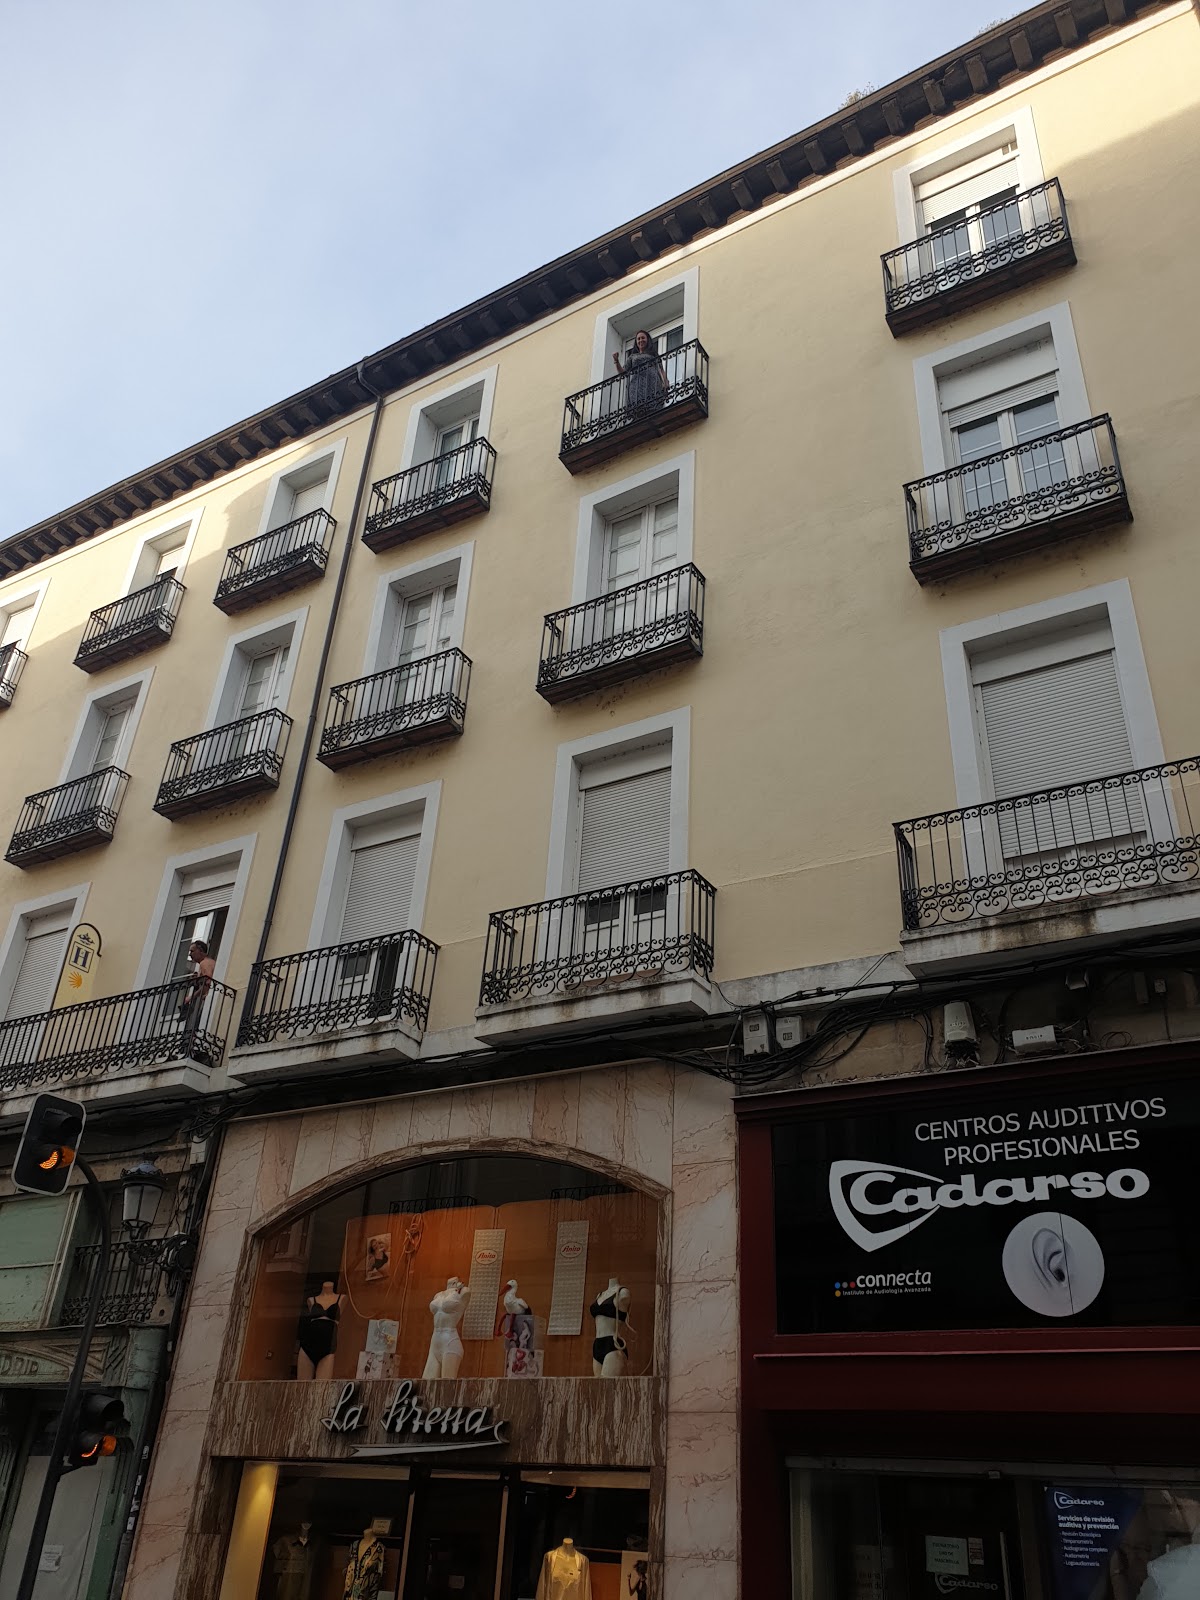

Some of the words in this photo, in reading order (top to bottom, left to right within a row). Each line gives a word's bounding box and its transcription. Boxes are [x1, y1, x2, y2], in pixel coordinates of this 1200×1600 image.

[71, 945, 92, 969] H
[914, 1112, 1021, 1142] CENTROS
[1027, 1097, 1168, 1130] AUDITIVOS
[943, 1129, 1141, 1166] PROFESIONALES
[849, 1167, 1150, 1216] Cadarso
[856, 1269, 932, 1288] connecta
[320, 1381, 367, 1433] La
[380, 1379, 500, 1436] Sirena
[1058, 1496, 1105, 1506] Cadarso
[939, 1575, 998, 1591] Cadarso
